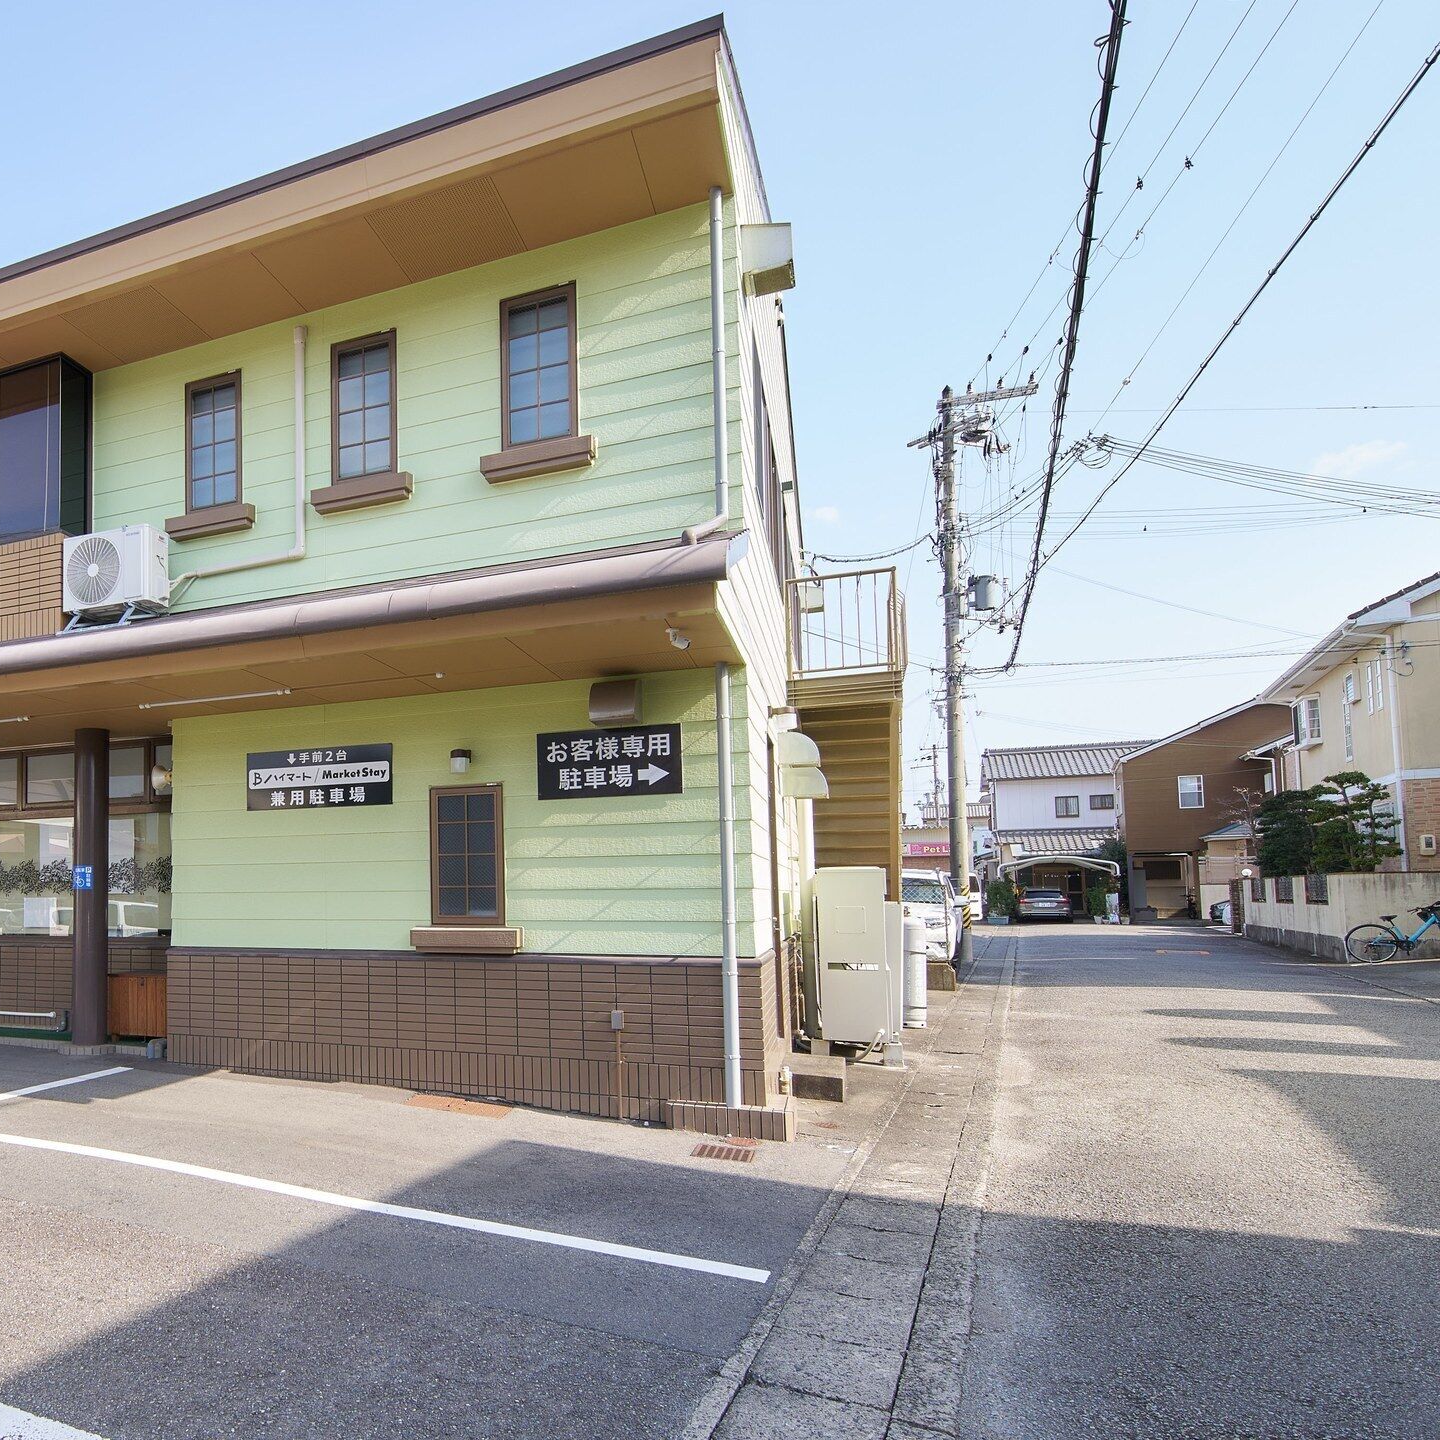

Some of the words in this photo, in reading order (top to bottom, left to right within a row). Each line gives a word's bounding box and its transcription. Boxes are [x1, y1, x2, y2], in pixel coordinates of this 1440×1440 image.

[299, 750, 347, 764] 手前2台
[546, 733, 670, 763] お客様専用
[558, 764, 633, 791] 駐車場
[270, 786, 366, 807] 兼用駐車場
